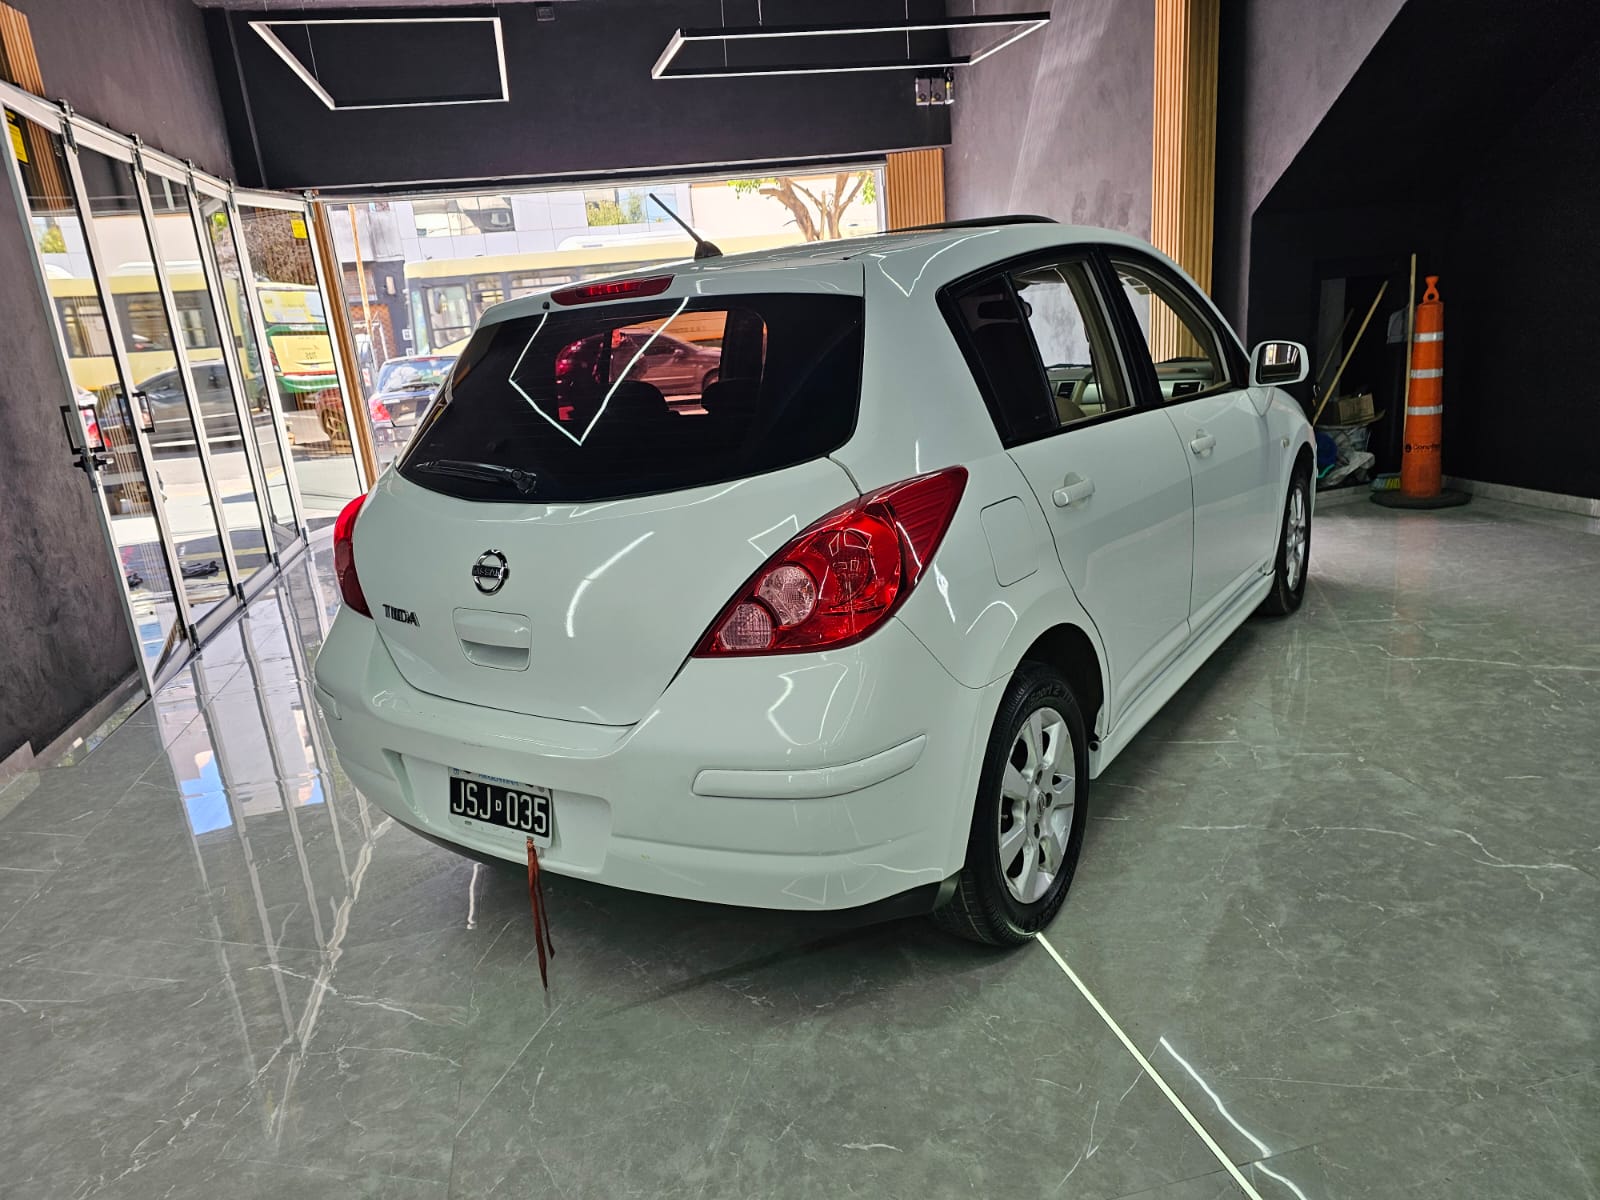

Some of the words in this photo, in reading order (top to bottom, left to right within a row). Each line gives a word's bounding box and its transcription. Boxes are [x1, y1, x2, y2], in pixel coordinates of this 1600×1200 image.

[382, 603, 420, 628] TIIDA
[452, 780, 491, 820] JSJ
[506, 791, 547, 834] 035
